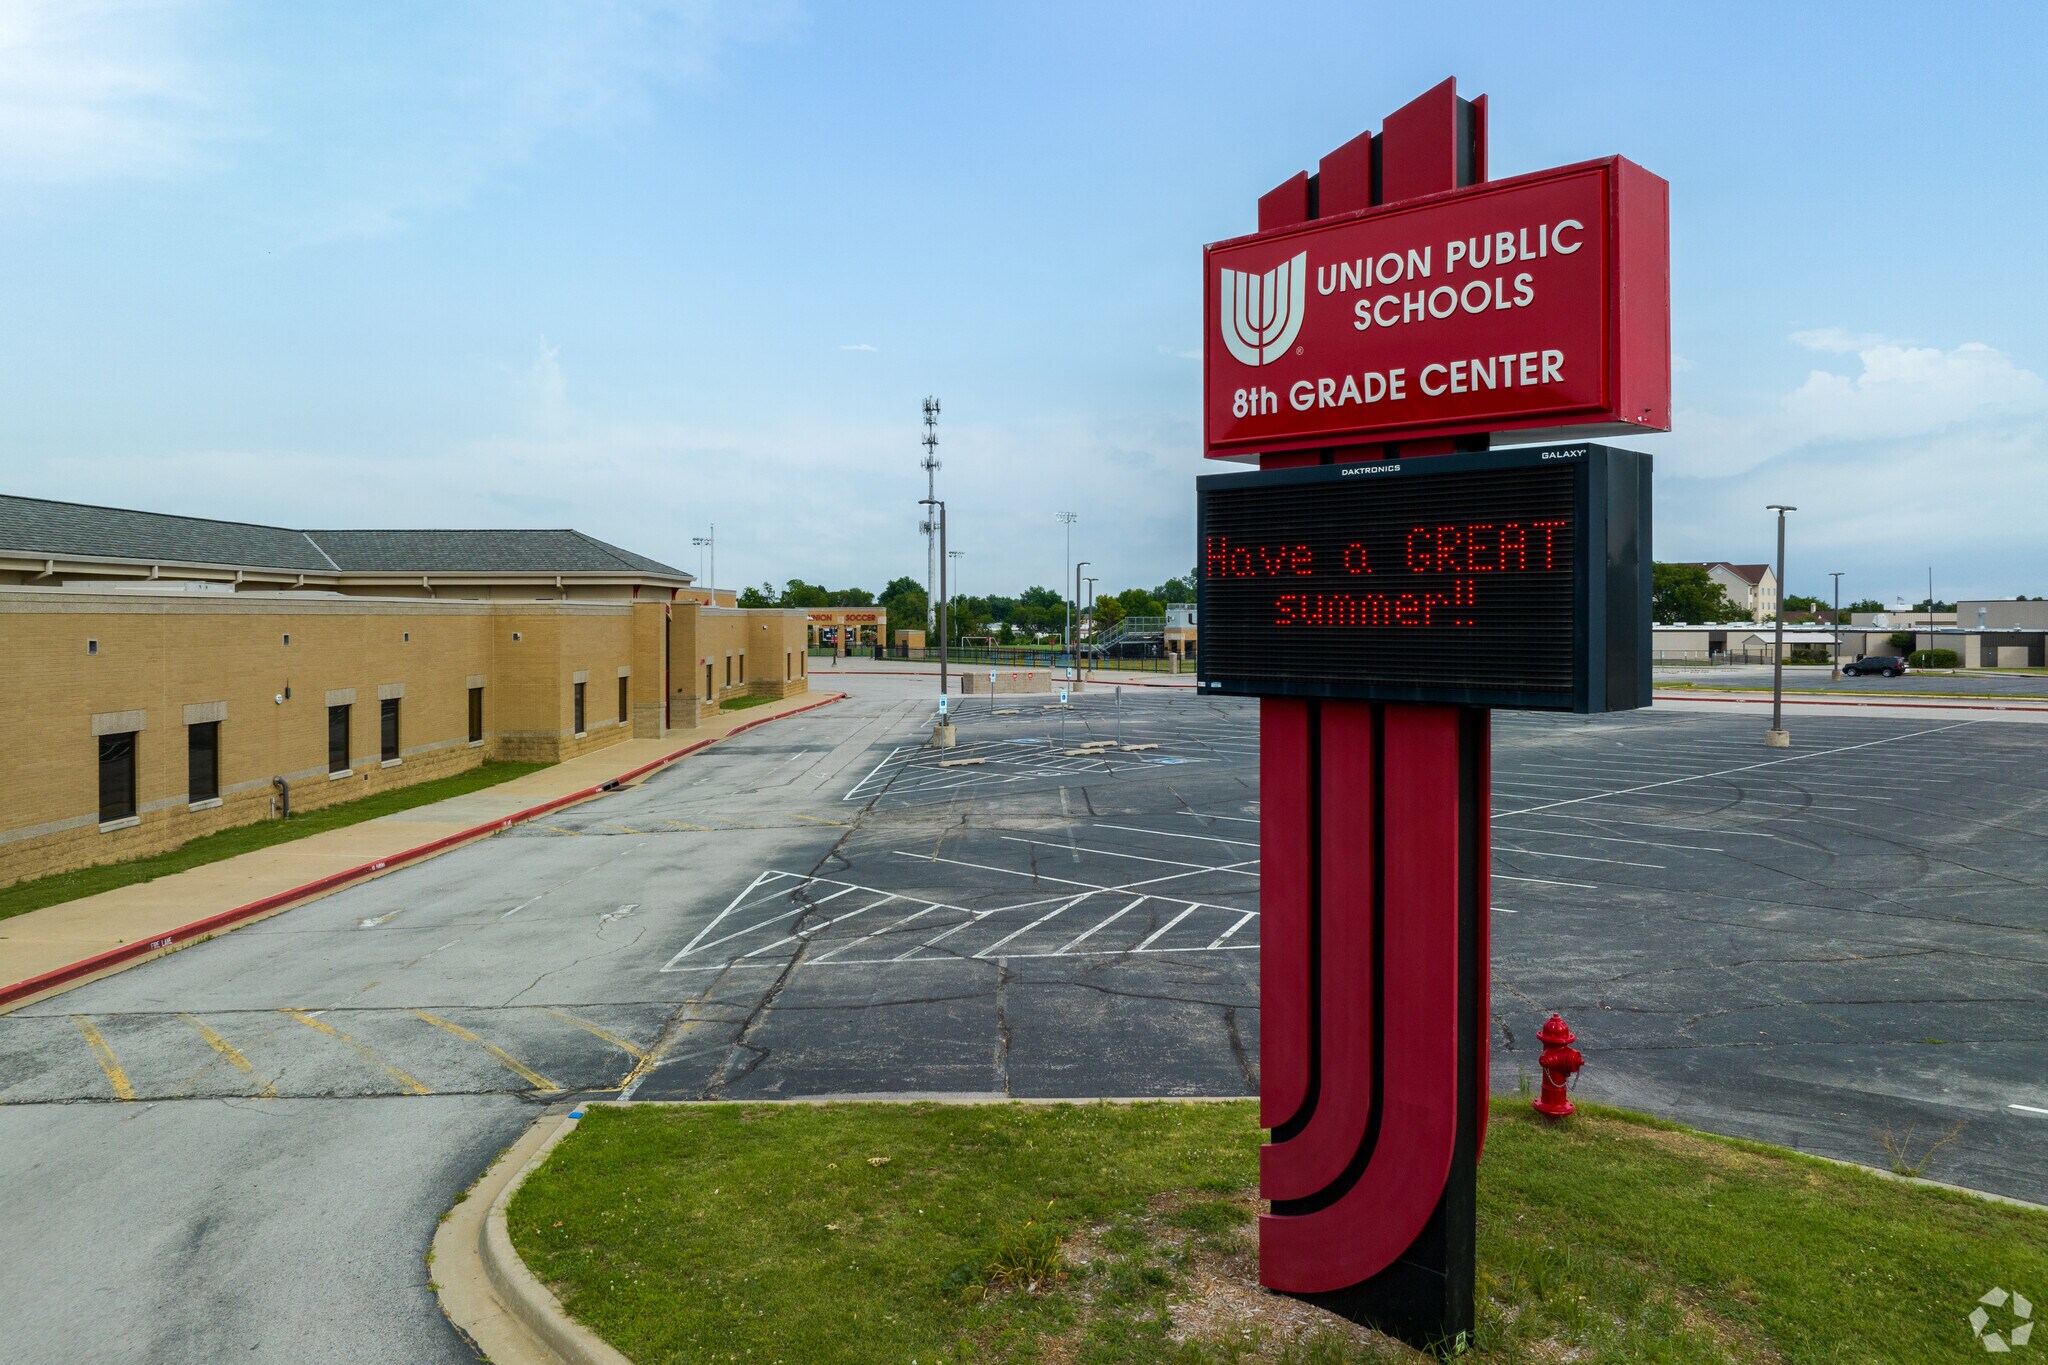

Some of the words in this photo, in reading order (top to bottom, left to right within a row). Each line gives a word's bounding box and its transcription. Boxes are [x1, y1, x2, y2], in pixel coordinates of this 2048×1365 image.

[1317, 245, 1432, 296] UNION
[1446, 219, 1585, 274] PUBLIC
[1353, 272, 1535, 331] SCHOOLS
[1232, 385, 1278, 419] 8th
[1289, 367, 1406, 412] GRADE
[1419, 349, 1565, 397] CENTER
[1341, 464, 1401, 476] DAKTRONICS
[1207, 536, 1312, 577] Have
[1344, 543, 1373, 574] a
[1407, 521, 1566, 573] GREAT
[1275, 579, 1474, 626] summer!!
